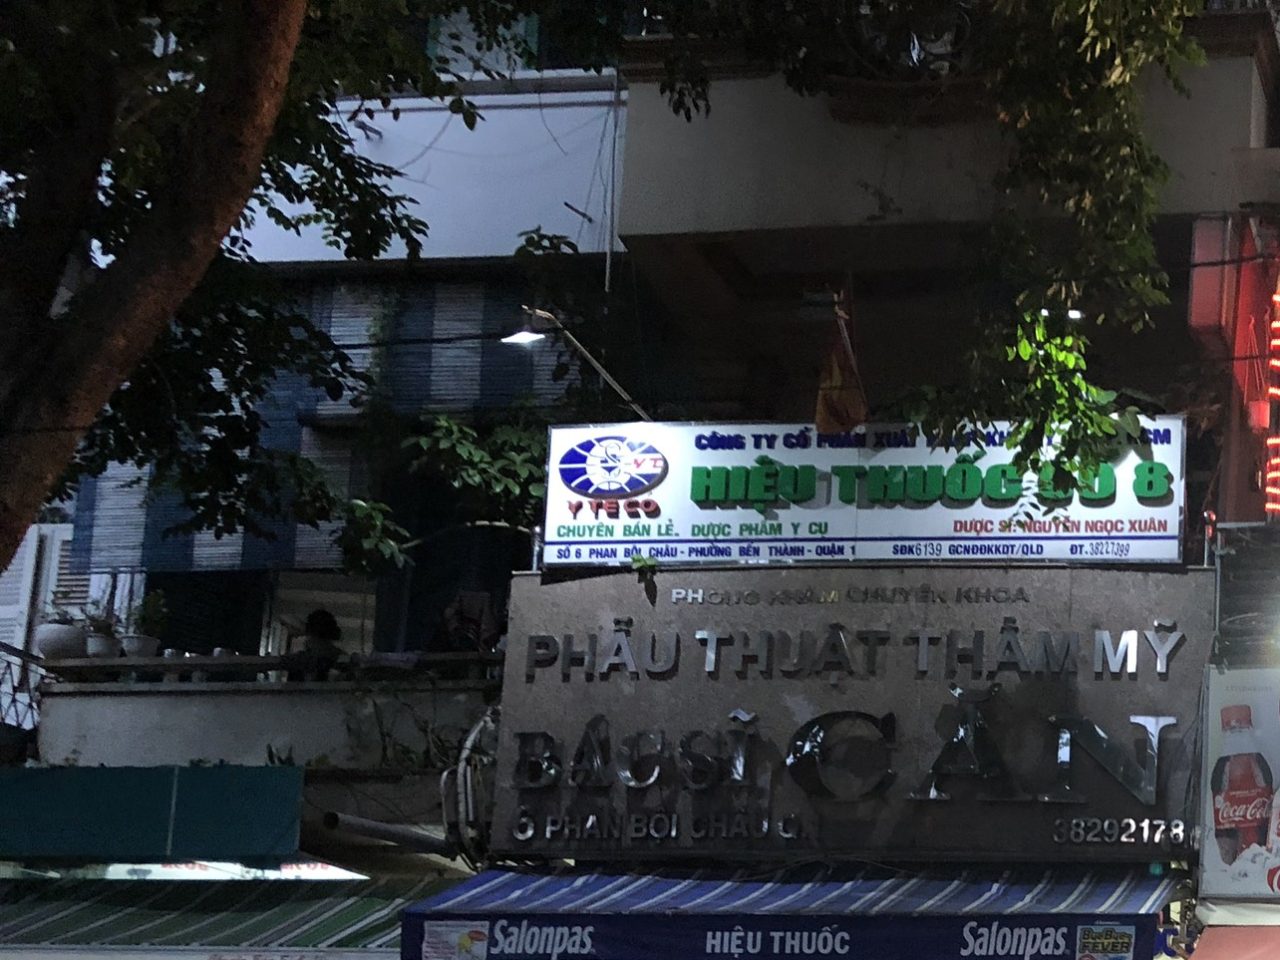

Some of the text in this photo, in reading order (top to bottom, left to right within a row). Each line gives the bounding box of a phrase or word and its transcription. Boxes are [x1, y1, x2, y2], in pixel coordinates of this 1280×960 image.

[752, 433, 777, 449] TY
[691, 455, 816, 514] HIỆU
[831, 450, 1024, 500] THUỐC
[1133, 461, 1171, 499] 8
[557, 522, 614, 537] CHUYÊN
[623, 521, 651, 537] BÁN
[691, 521, 731, 538] DƯỢC
[740, 521, 782, 536] PHẨM
[791, 522, 800, 535] Y
[808, 521, 828, 539] CỤ
[953, 519, 993, 536] DƯỢC
[1085, 519, 1123, 535] NGỌC
[1129, 516, 1168, 533] XUÂN
[557, 544, 570, 559] SỐ
[575, 548, 581, 558] 6
[589, 547, 617, 558] PHAN
[649, 545, 678, 558] CHÂU
[688, 543, 732, 557] PHƯỜNG
[739, 543, 760, 557] BẾN
[768, 543, 805, 557] THÀNH
[815, 544, 845, 559] QUẬN
[850, 545, 855, 555] 1
[955, 586, 1030, 603] KHOA
[695, 621, 891, 686] THUẬT
[1093, 618, 1186, 680] MỸ
[545, 813, 622, 839] PHAN
[631, 809, 678, 843] BỘI
[1053, 818, 1185, 844] 38292178
[706, 925, 761, 958] HIỆU
[769, 925, 850, 955] THUỐC
[1079, 942, 1130, 953] FEVER
